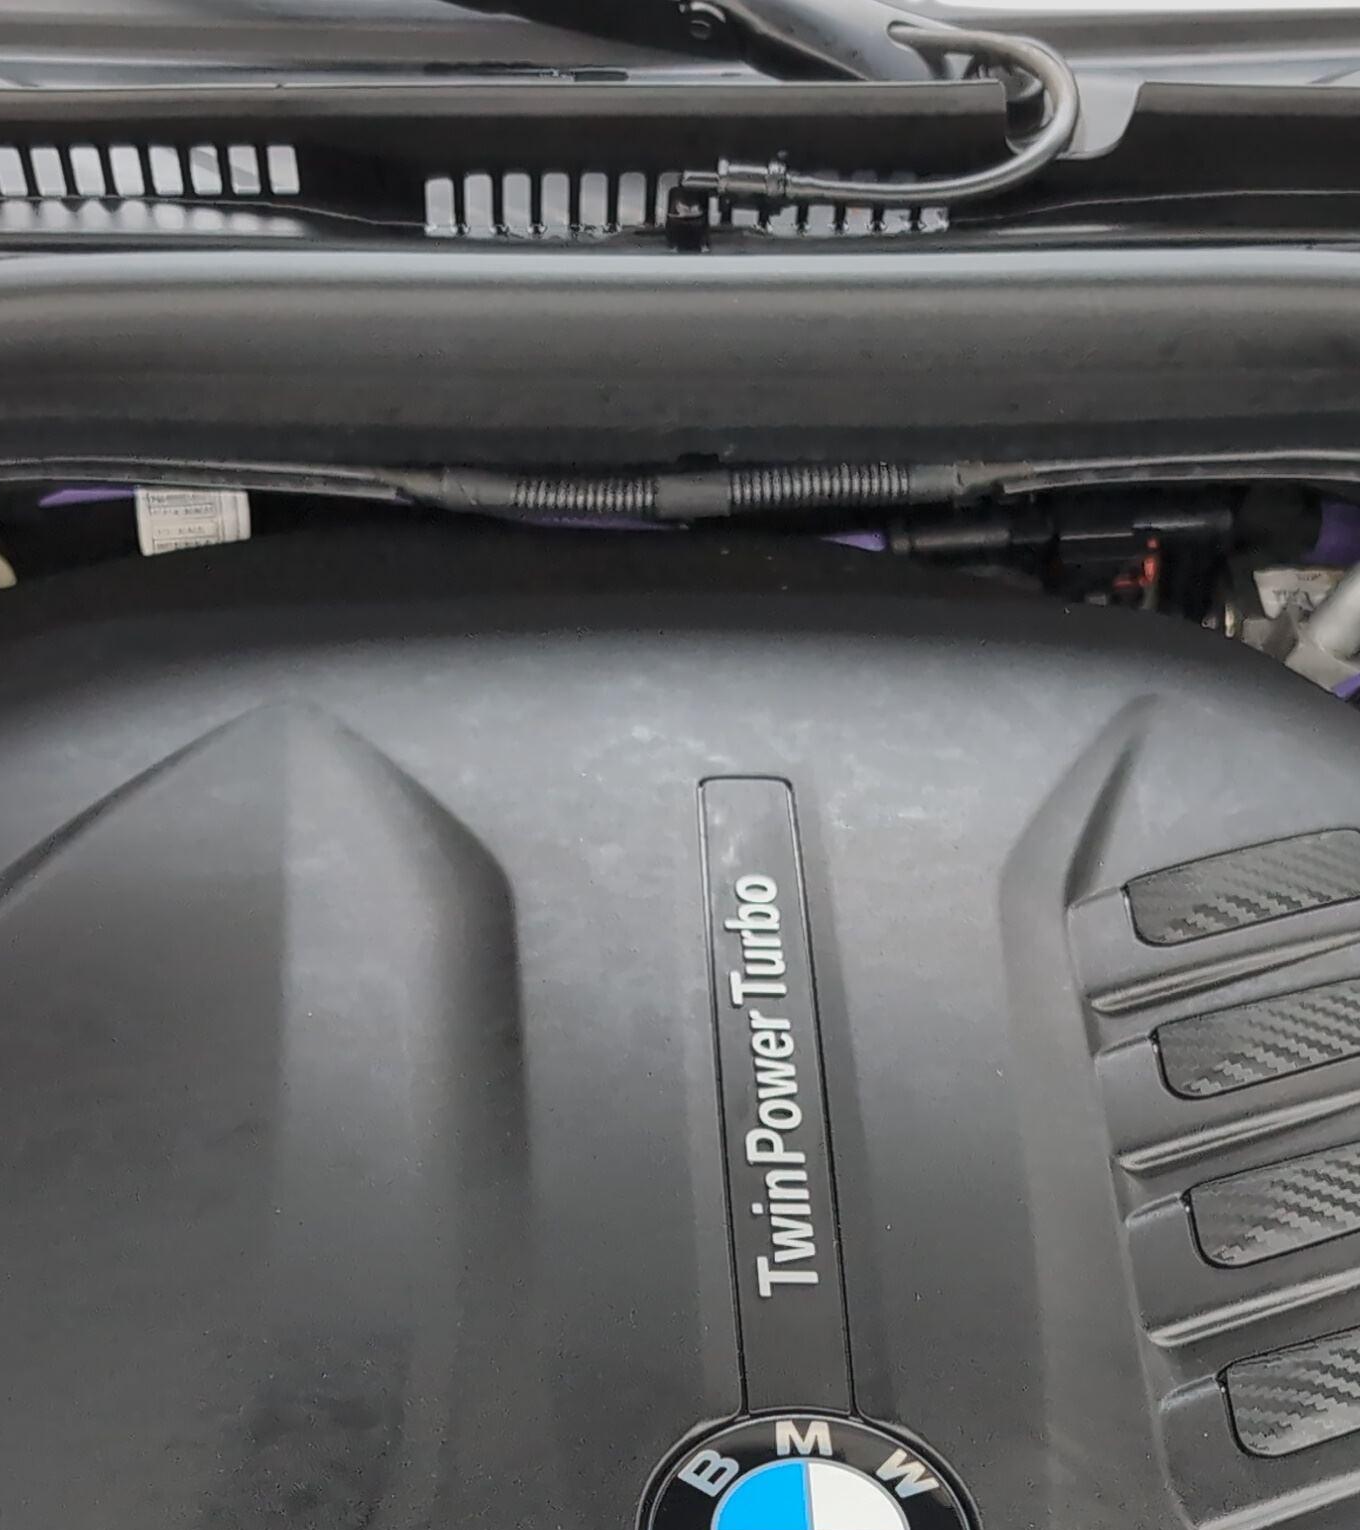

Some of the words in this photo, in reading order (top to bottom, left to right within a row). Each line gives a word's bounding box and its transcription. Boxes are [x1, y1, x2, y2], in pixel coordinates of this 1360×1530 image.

[724, 874, 788, 1009] Turbo
[744, 1009, 820, 1298] TwinPower
[676, 1419, 941, 1499] BMW
